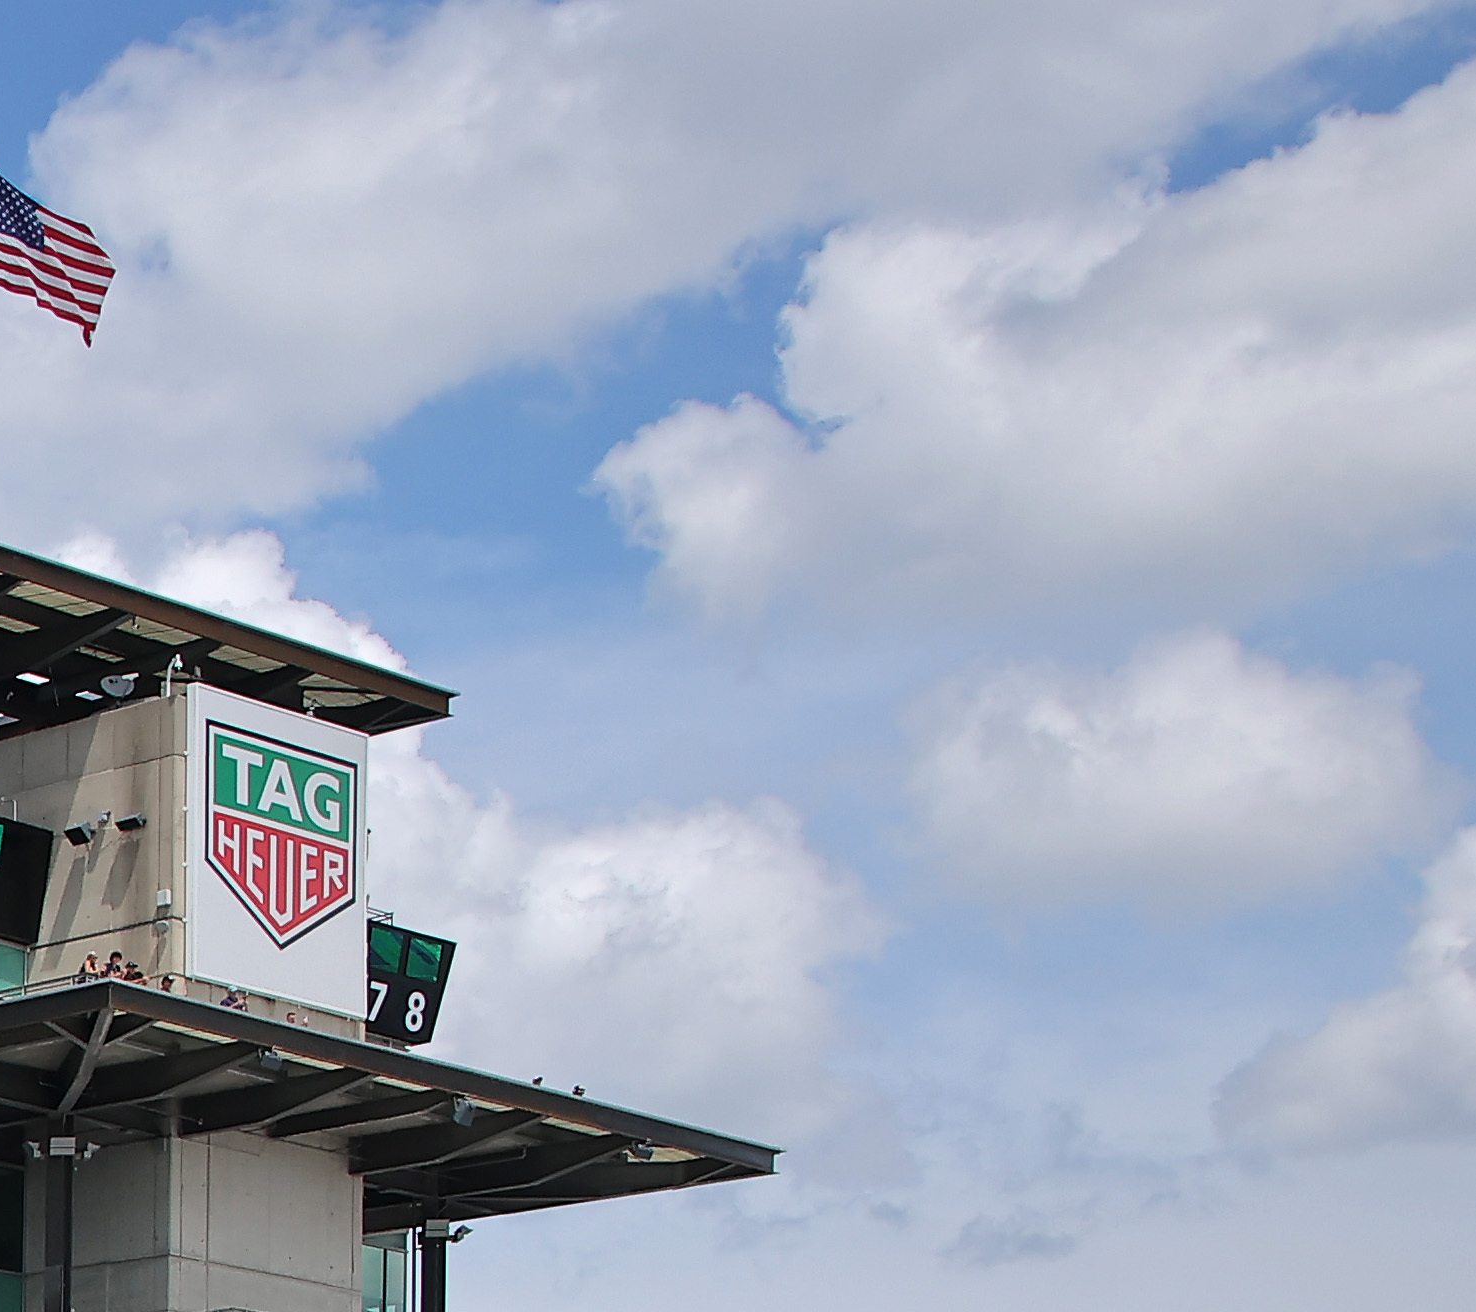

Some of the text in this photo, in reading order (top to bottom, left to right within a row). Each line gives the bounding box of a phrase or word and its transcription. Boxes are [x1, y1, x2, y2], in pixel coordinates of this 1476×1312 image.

[220, 742, 342, 833] TAG
[216, 814, 347, 928] HEUER
[369, 980, 426, 1033] 7 8
